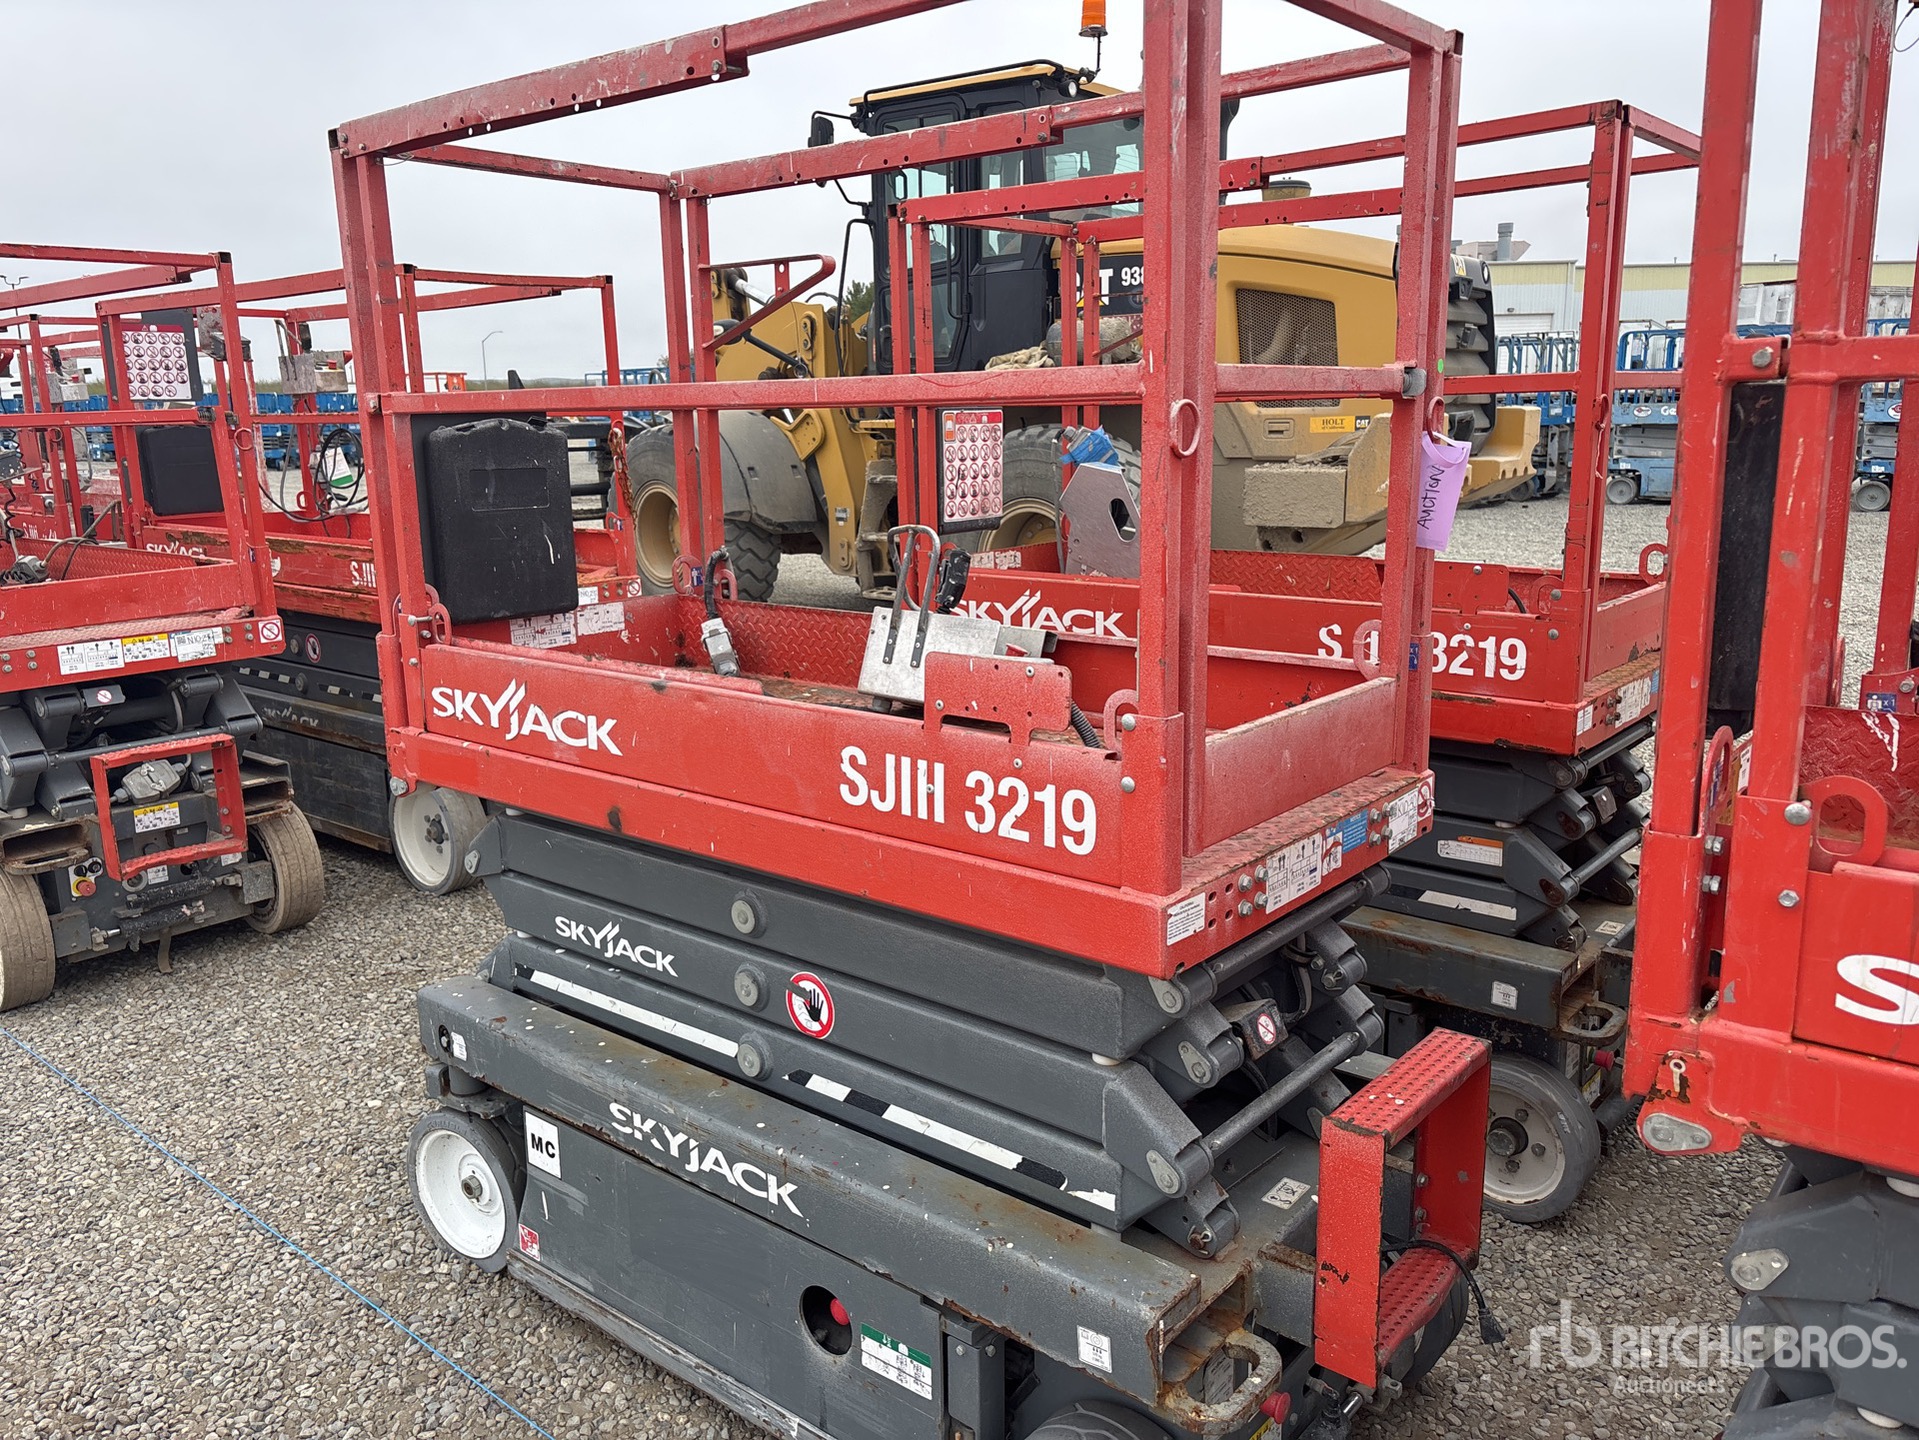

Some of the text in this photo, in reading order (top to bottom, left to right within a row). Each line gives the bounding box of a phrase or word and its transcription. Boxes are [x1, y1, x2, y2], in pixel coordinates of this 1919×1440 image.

[1322, 418, 1369, 428] HOLT CAT
[1417, 465, 1445, 530] AUCTION
[431, 678, 623, 756] SKYJACK
[964, 770, 1097, 856] 3219
[555, 916, 678, 977] SKYJACK
[531, 1133, 556, 1159] MC
[609, 1102, 803, 1217] SKYJACK
